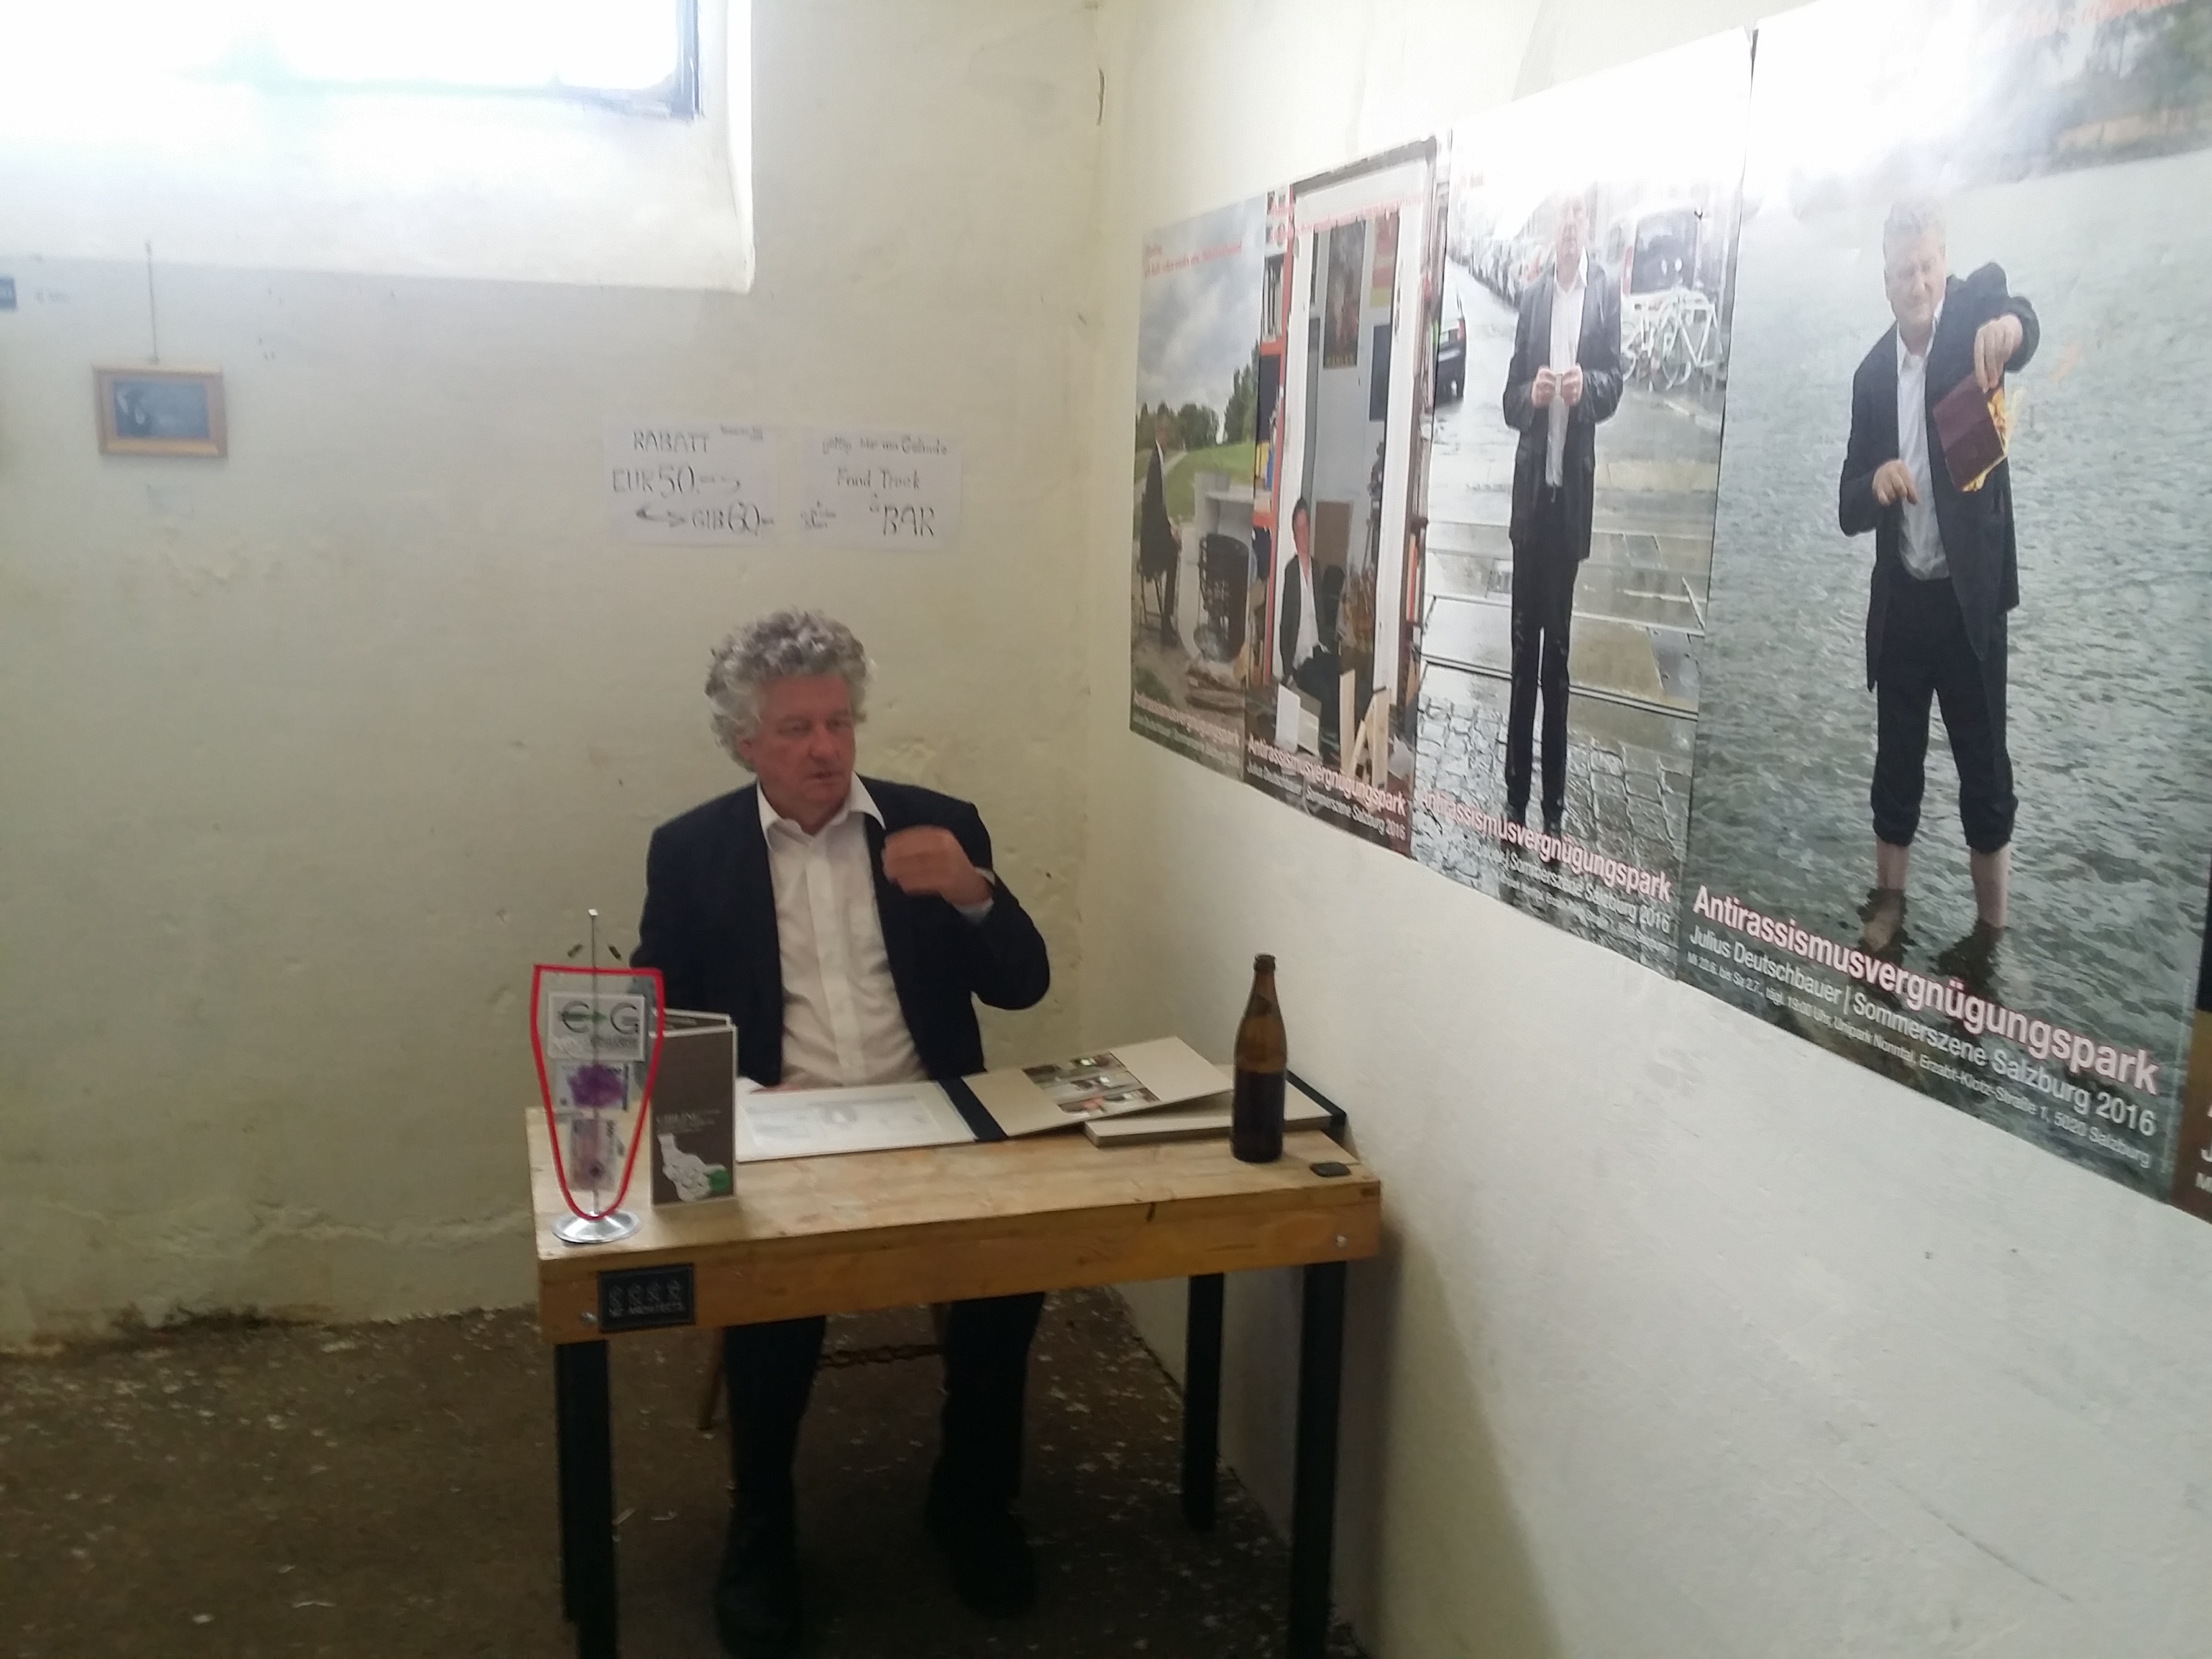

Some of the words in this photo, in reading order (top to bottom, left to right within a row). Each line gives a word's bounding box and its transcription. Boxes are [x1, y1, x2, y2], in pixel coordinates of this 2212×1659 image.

[634, 430, 710, 453] RABATT
[613, 468, 654, 493] EUR
[882, 504, 935, 537] BAR
[1385, 818, 1407, 841] 2016
[1639, 904, 1670, 933] 2016
[1693, 884, 2160, 1096] Antirassismusvergnügungspark
[1689, 925, 1731, 958] Julius
[1734, 941, 1843, 1003] Deutschbauer
[1853, 991, 1988, 1067] Sommerszene
[1991, 1049, 2092, 1115] Salzburg
[2096, 1092, 2156, 1137] 2016
[2053, 1111, 2088, 1139] 5020
[2089, 1125, 2151, 1169] Salzburg
